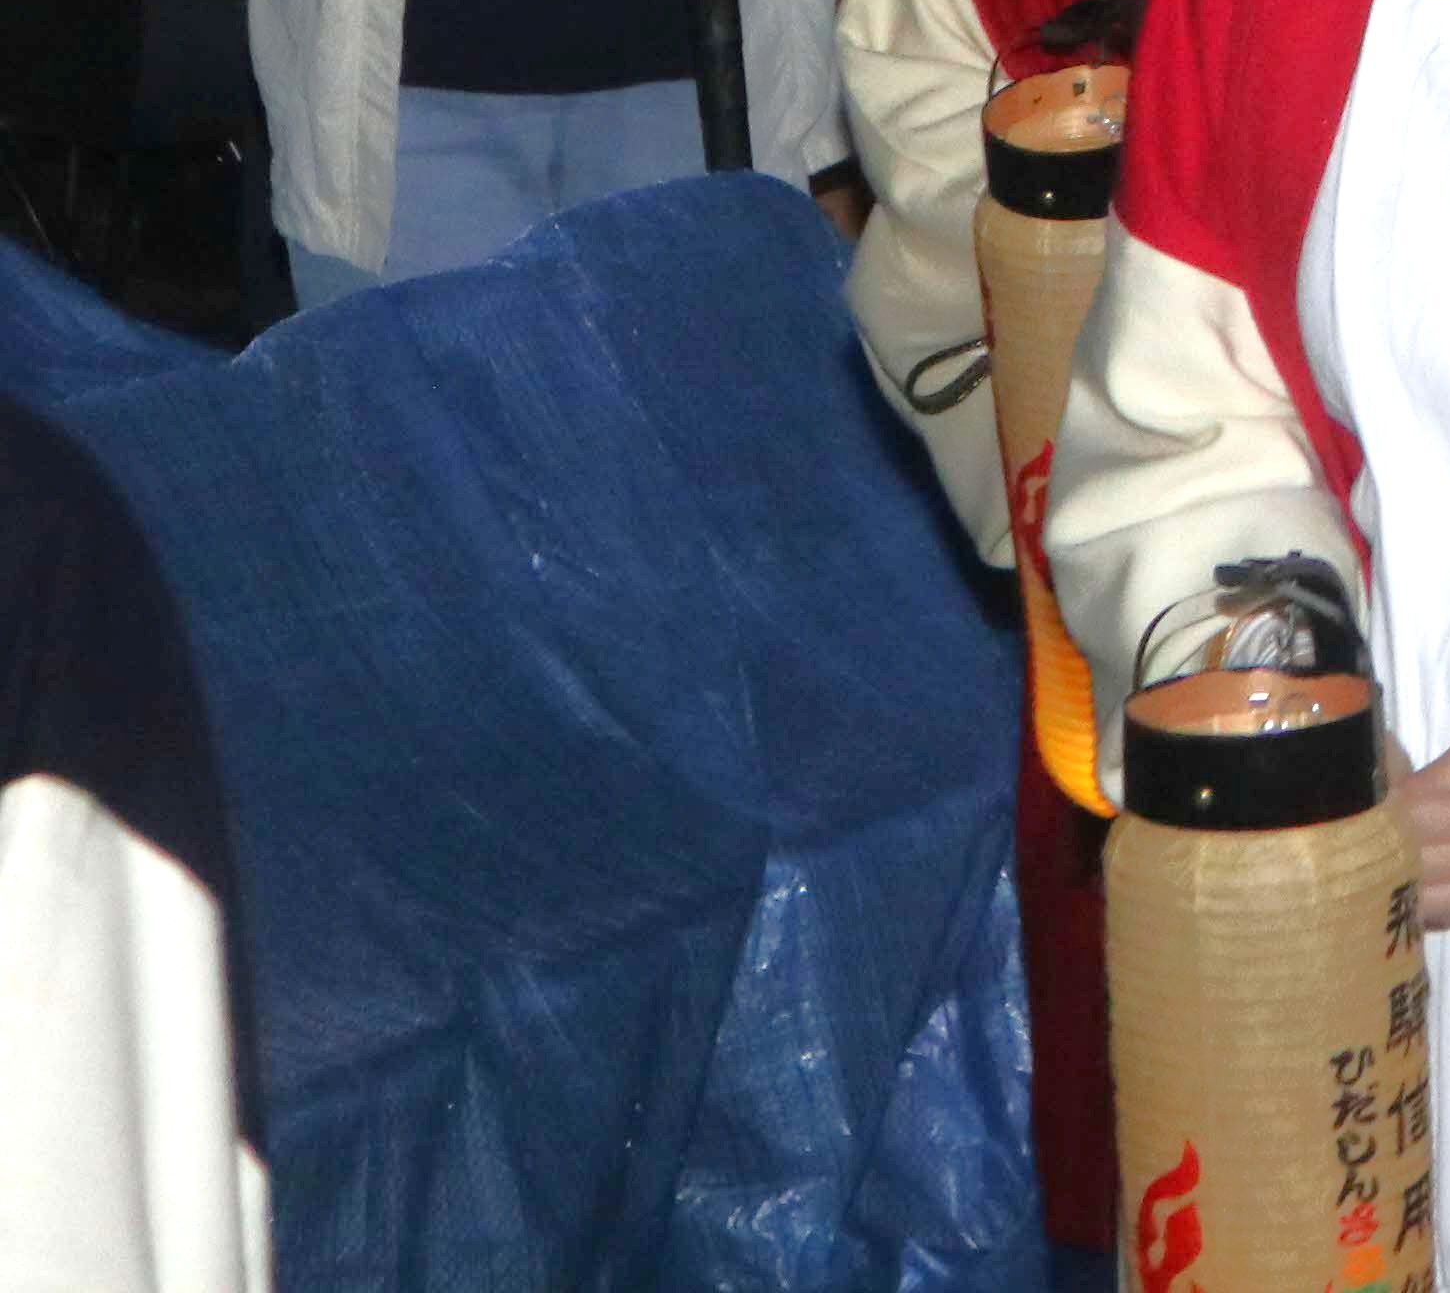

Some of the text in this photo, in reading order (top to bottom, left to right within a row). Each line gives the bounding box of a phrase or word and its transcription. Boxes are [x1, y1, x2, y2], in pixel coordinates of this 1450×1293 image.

[1329, 1045, 1380, 1209] ひだしん
[1385, 878, 1435, 1293] 飛騨信用
